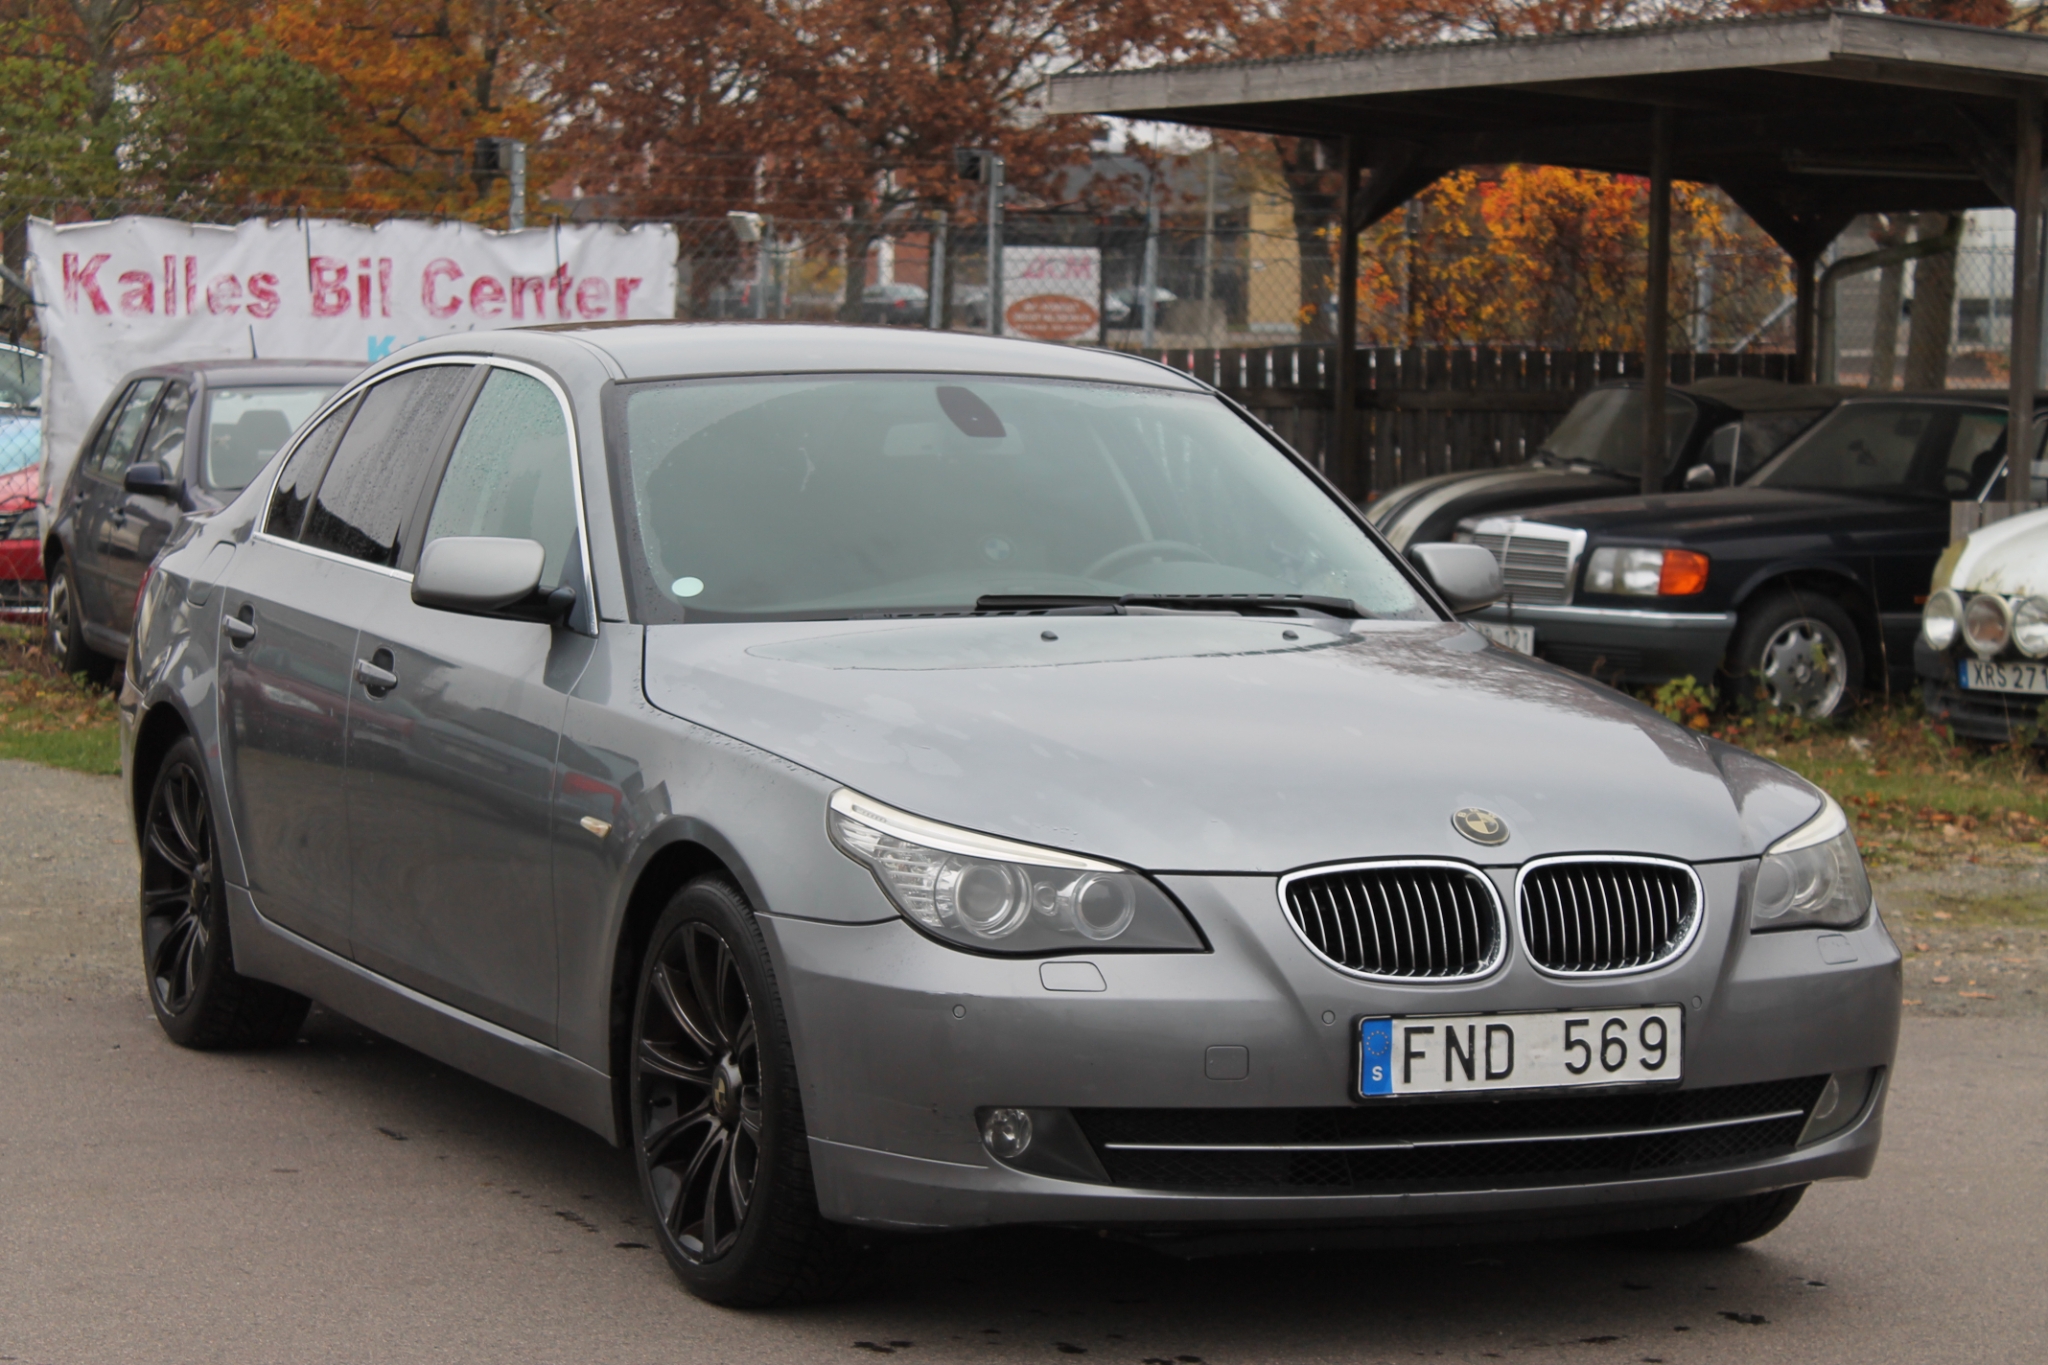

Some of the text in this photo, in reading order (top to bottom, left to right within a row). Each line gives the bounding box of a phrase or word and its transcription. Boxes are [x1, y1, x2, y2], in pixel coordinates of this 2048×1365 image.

[62, 251, 644, 320] Kalles Bil Center
[1973, 661, 2008, 688] XRS
[1371, 1065, 1384, 1082] S
[1402, 1015, 1668, 1084] FND 569
